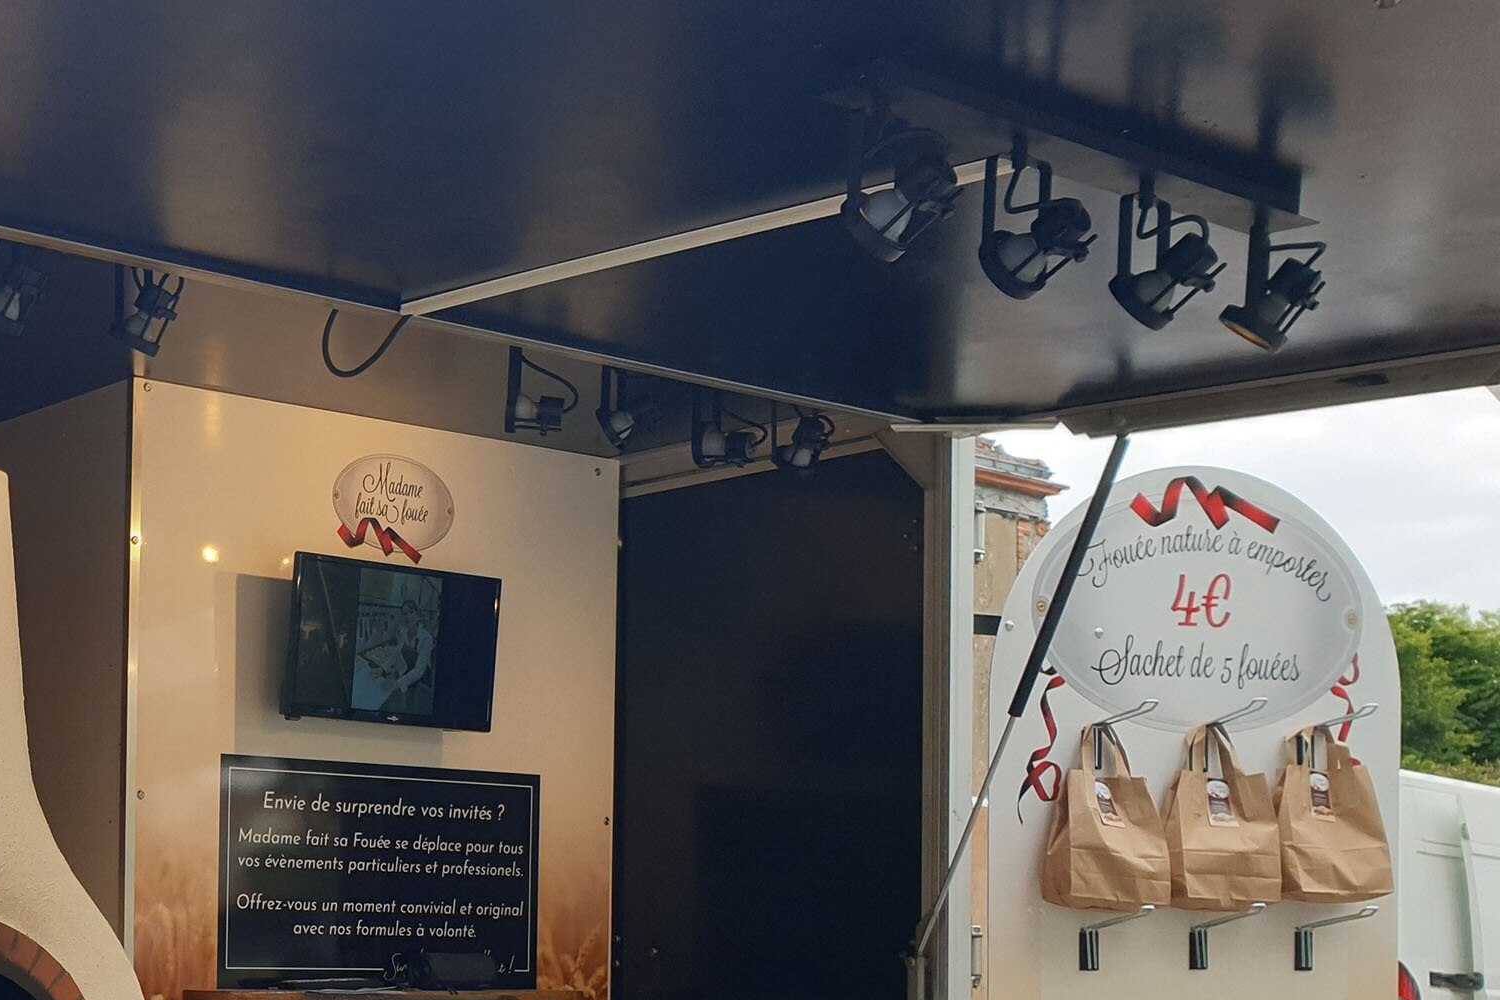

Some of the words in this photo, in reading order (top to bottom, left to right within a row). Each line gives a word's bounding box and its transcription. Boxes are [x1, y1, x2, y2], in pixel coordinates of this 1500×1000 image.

[362, 461, 424, 502] Madame
[354, 492, 375, 519] fait
[377, 500, 399, 524] sa
[401, 499, 429, 525] fouée
[1076, 534, 1157, 588] Fouée
[1161, 525, 1225, 556] nature
[1228, 530, 1242, 556] à
[1246, 540, 1332, 602] emporter
[1170, 573, 1232, 628] 4€
[1091, 634, 1185, 686] Sachet
[1190, 641, 1216, 679] de
[1220, 656, 1232, 684] 5
[1238, 643, 1300, 690] fouées
[263, 791, 306, 811] Envie
[311, 793, 331, 813] de
[335, 798, 416, 818] surprendre
[421, 805, 444, 818] vos
[449, 803, 492, 820] invités
[497, 804, 505, 821] ?
[238, 827, 301, 846] Madame
[305, 829, 330, 848] fait
[333, 834, 348, 848] sa
[353, 832, 391, 850] Fouée
[395, 838, 409, 851] se
[412, 835, 462, 853] déplace
[465, 841, 494, 856] pour
[498, 841, 524, 856] tous
[237, 855, 260, 868] vos
[264, 853, 344, 872] évènements
[348, 856, 421, 875] particuliers
[425, 861, 439, 875] et
[441, 859, 524, 878] professionels.
[236, 893, 317, 912] Offrez-vous
[321, 900, 338, 912] un
[342, 900, 397, 914] moment
[400, 899, 456, 916] convivial
[460, 902, 473, 916] et
[476, 901, 524, 920] original
[293, 923, 325, 937] avec
[329, 924, 352, 937] nos
[356, 920, 412, 938] formules
[416, 921, 425, 938] à
[429, 922, 477, 939] volonté.
